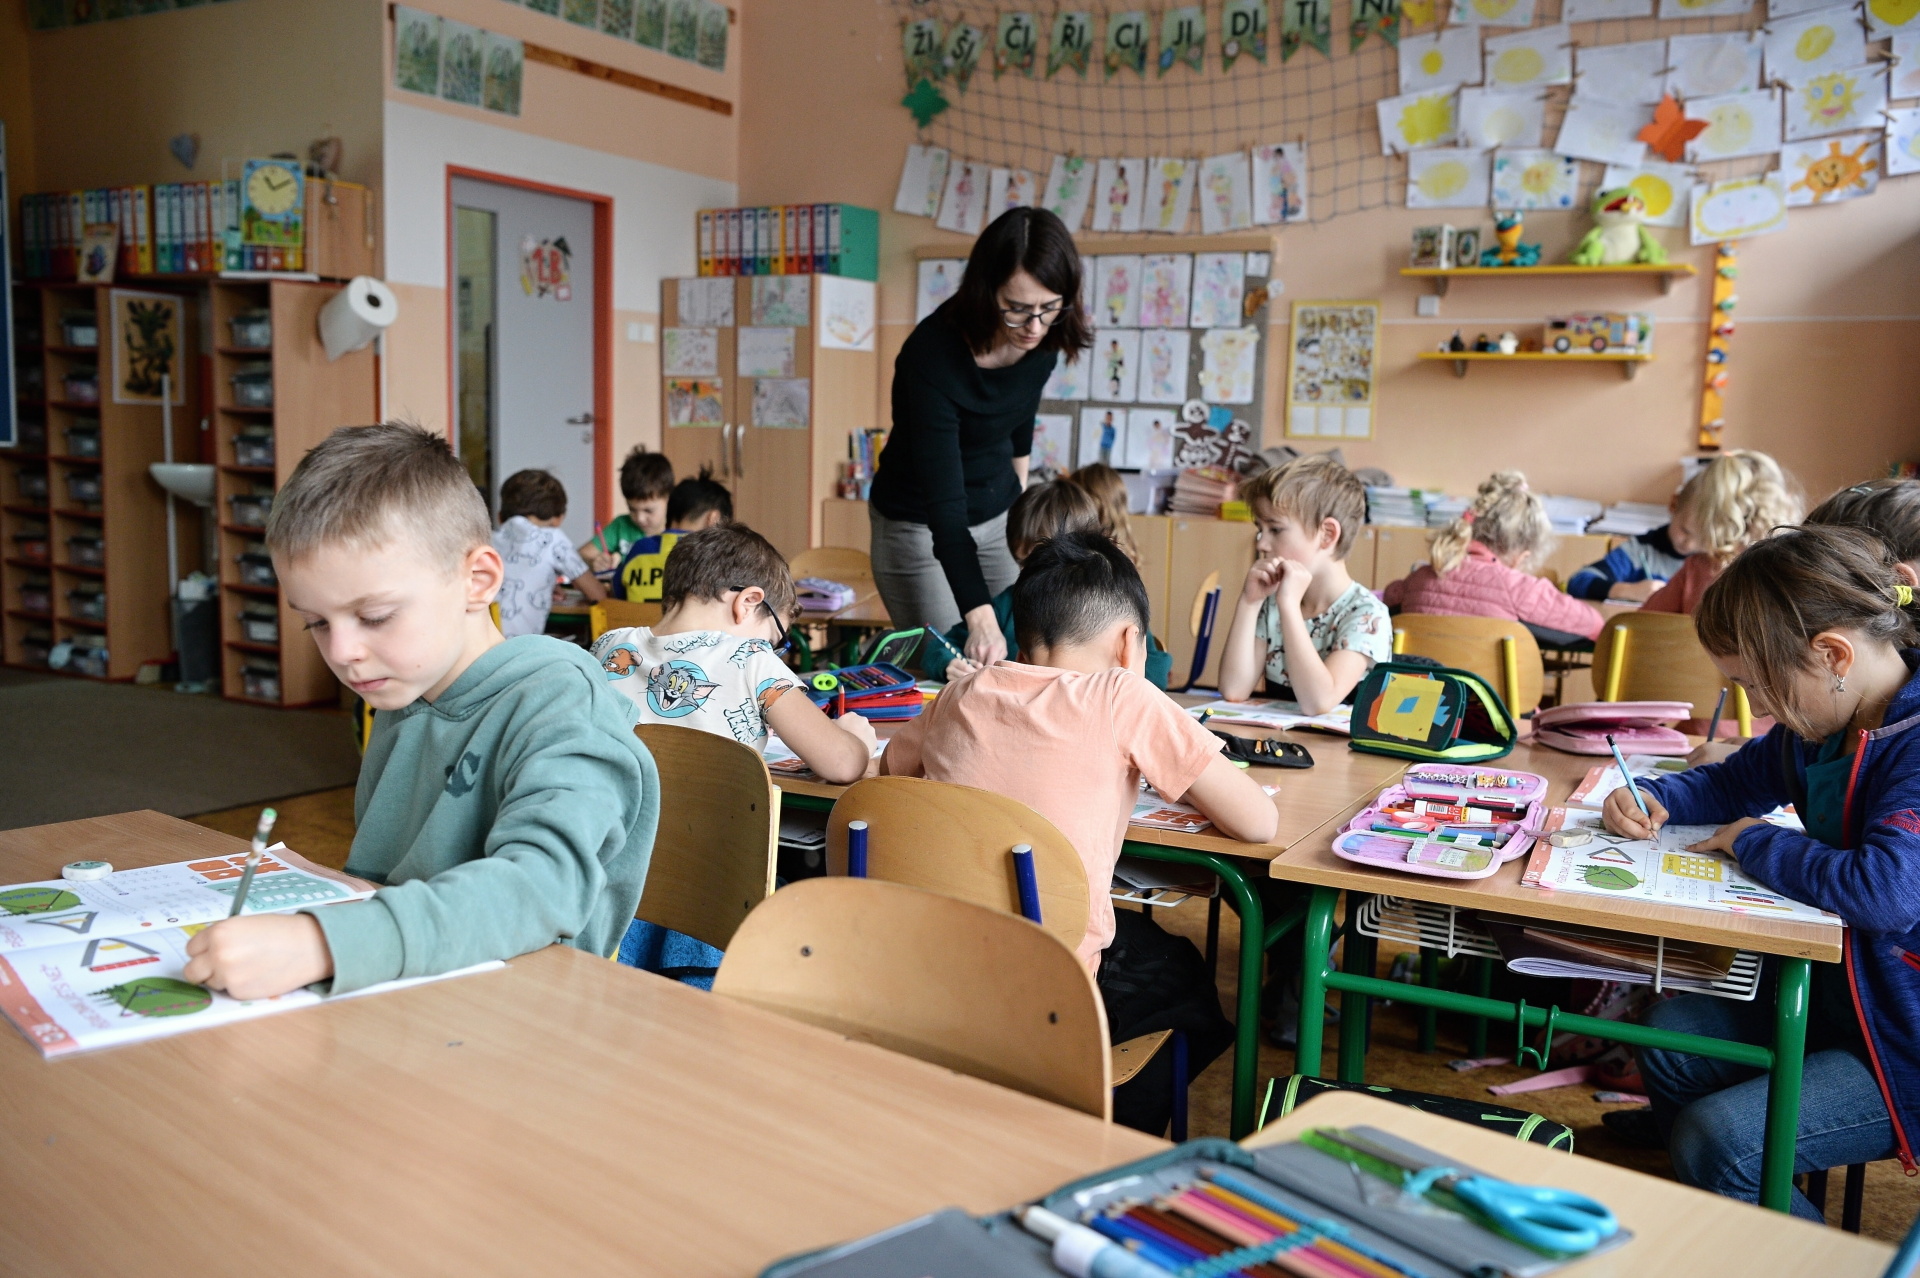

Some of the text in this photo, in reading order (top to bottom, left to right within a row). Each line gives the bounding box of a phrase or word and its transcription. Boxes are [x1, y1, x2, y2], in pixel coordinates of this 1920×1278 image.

[1005, 15, 1030, 50] ČI
[1060, 15, 1085, 49] ŘI
[1114, 23, 1141, 49] CI
[1173, 19, 1193, 46] JI
[1231, 9, 1259, 37] DI
